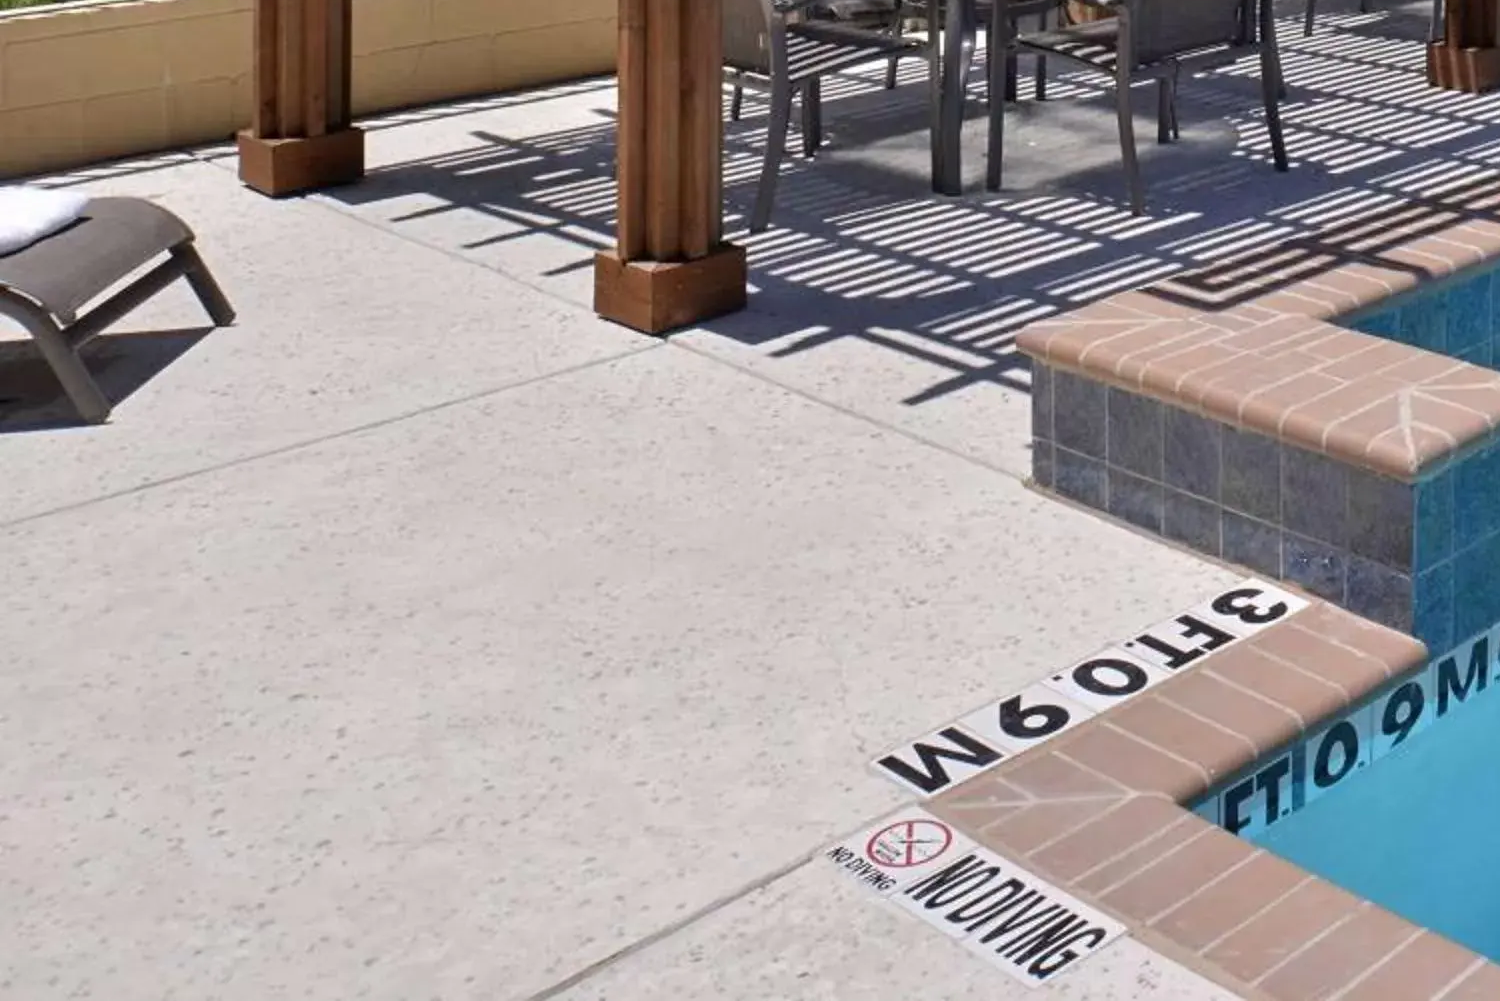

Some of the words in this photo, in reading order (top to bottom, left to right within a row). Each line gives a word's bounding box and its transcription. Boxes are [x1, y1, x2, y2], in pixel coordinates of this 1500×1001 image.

[1211, 587, 1288, 625] 3
[1125, 614, 1238, 670] FT.
[826, 846, 855, 864] NO
[844, 856, 897, 891] DIVING
[903, 854, 1001, 910] NO
[944, 877, 1107, 980] DIVING
